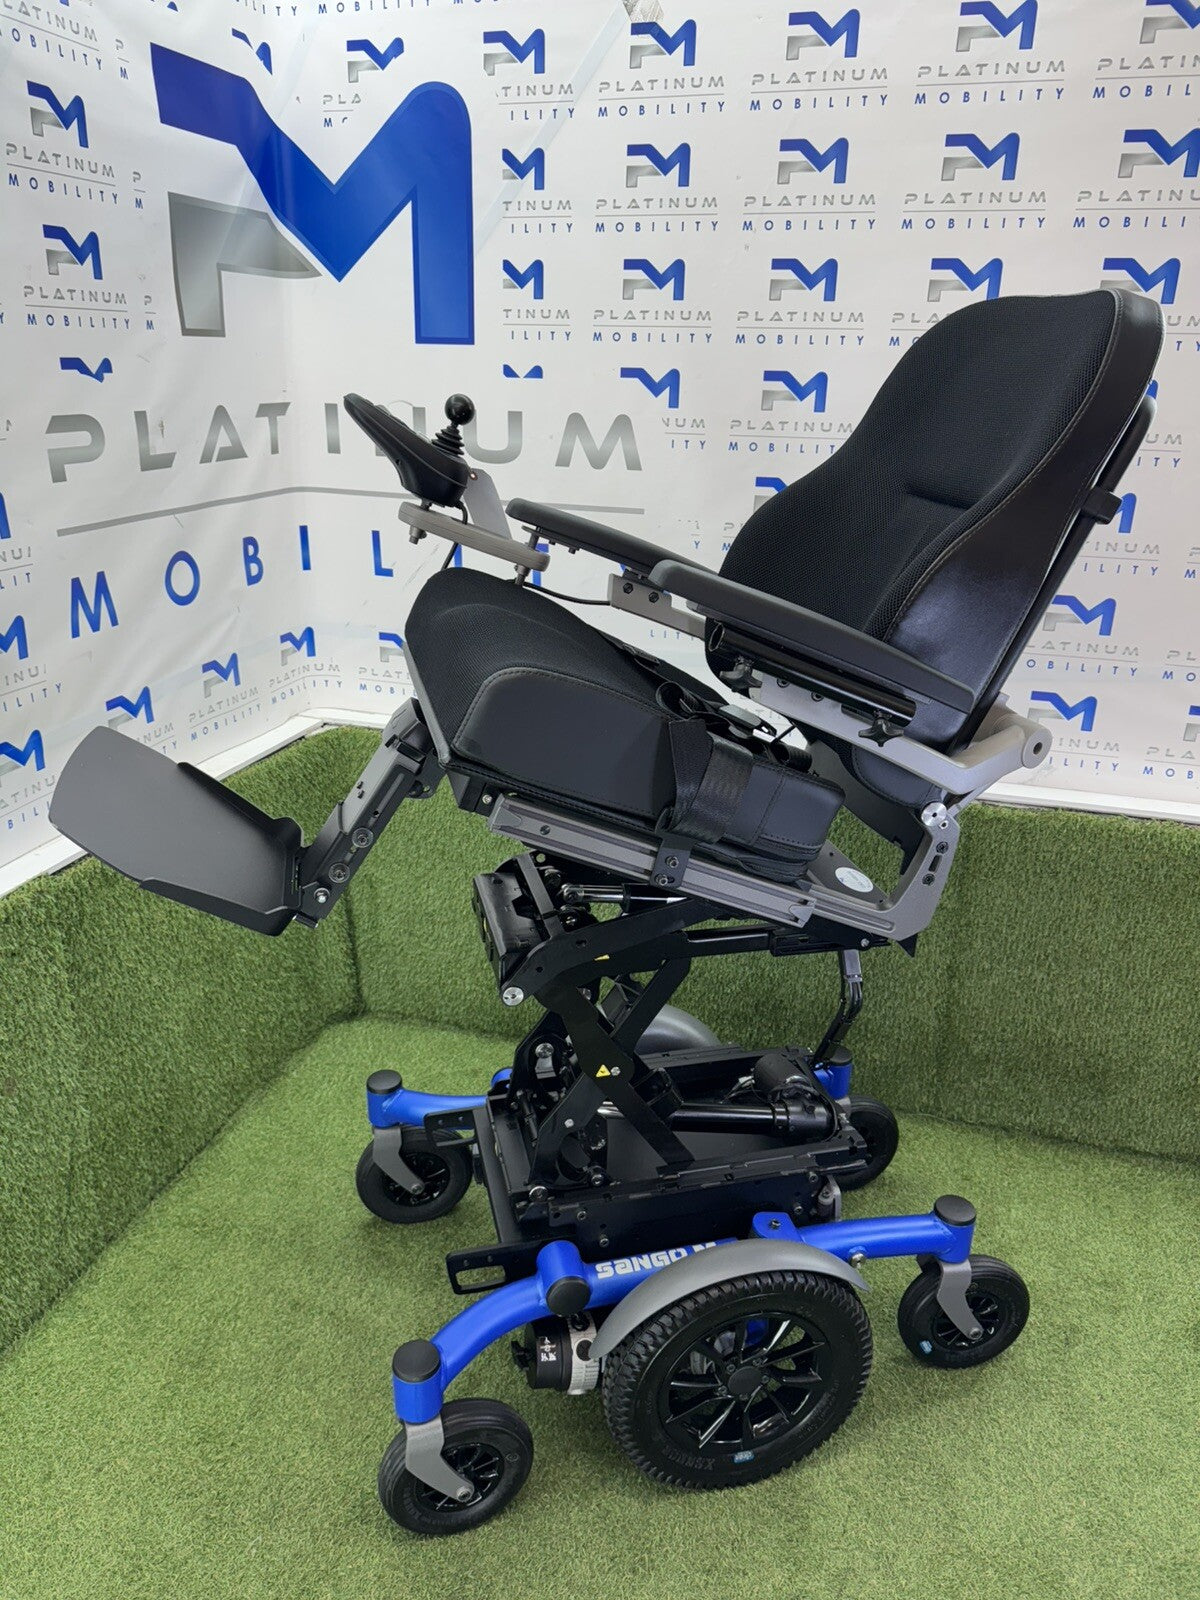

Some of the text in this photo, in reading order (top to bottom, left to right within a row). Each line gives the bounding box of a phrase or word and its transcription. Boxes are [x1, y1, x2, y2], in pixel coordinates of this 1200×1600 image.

[752, 67, 888, 85] PLATINUM
[917, 60, 1066, 79] PLATINUM
[599, 75, 725, 93] PLATINUM
[750, 94, 889, 111] MOBILITY
[915, 88, 1065, 104] MOBILITY
[598, 101, 726, 118] MOBILITY
[6, 142, 115, 178] PLATINUM
[8, 173, 118, 205] MOBILITY
[904, 190, 1047, 205] PLATINUM
[595, 197, 718, 210] PLATINUM
[744, 194, 876, 208] PLATINUM
[595, 220, 719, 234] MOBILITY
[742, 219, 876, 231] MOBILITY
[901, 217, 1046, 230] MOBILITY
[23, 285, 127, 305] PLATINUM
[27, 313, 130, 330] MOBILITY
[593, 309, 712, 321] PLATINUM
[737, 310, 864, 323] PLATINUM
[592, 331, 712, 344] MOBILITY
[735, 333, 864, 346] MOBILITY
[730, 419, 853, 433] PLATINUM
[269, 663, 341, 688] PLATINUM
[271, 680, 343, 704] MOBILITY
[188, 686, 260, 723] PLATINUM
[191, 704, 262, 742] MOBILITY
